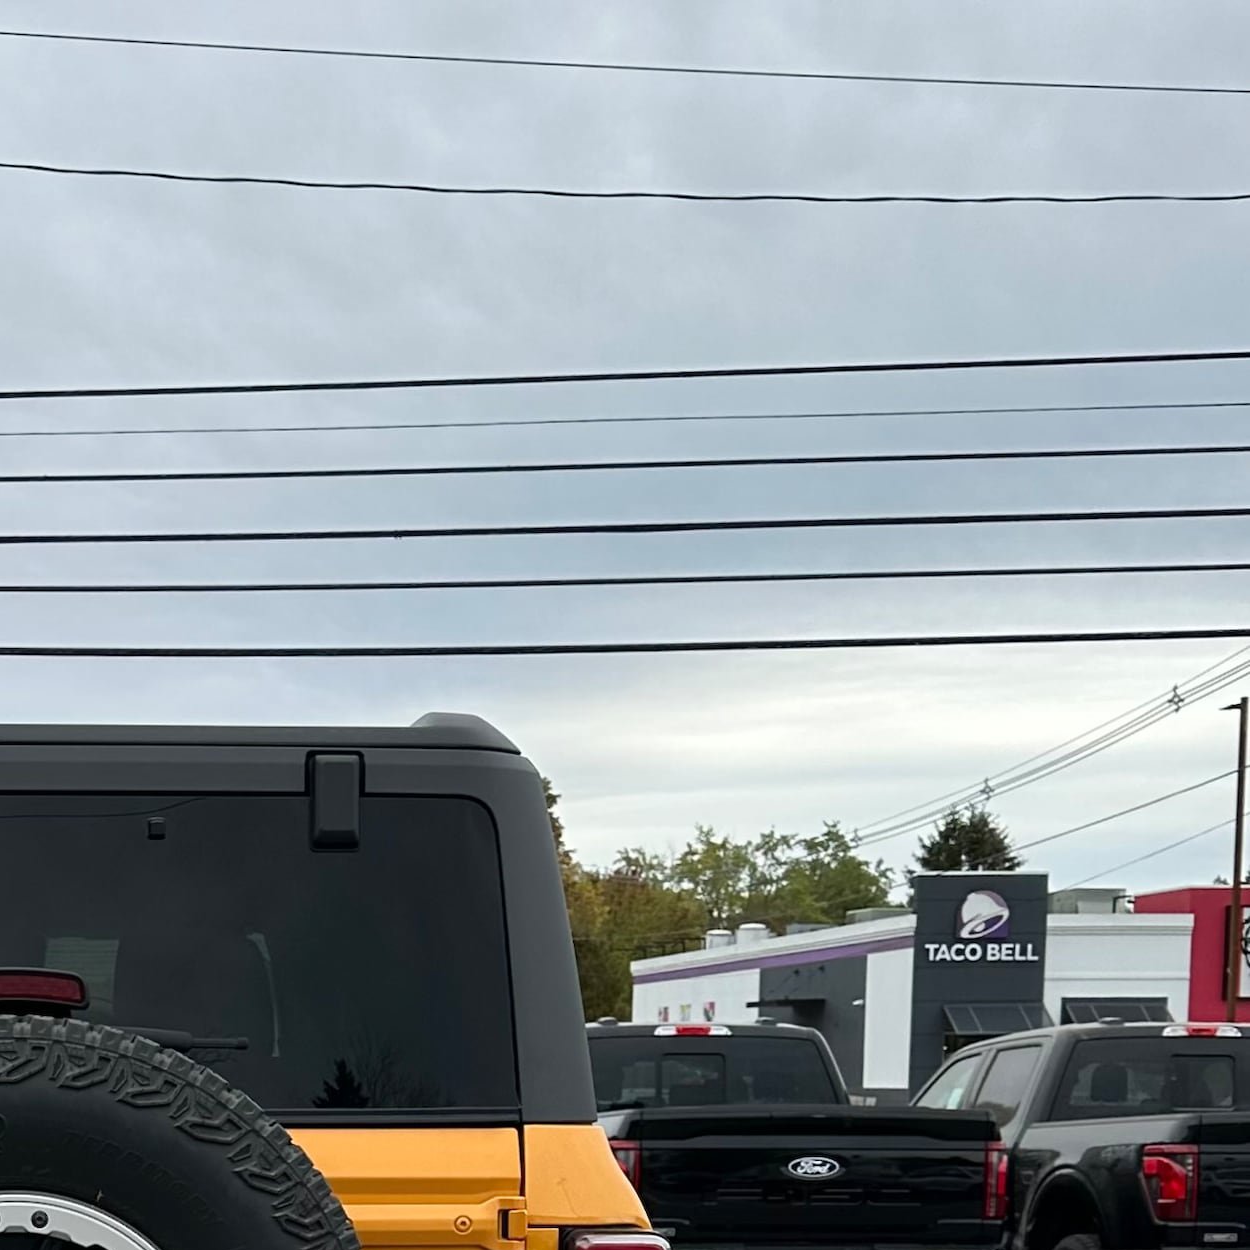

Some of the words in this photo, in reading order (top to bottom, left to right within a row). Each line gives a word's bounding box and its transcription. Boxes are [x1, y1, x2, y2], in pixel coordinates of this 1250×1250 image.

[924, 942, 982, 961] TACO
[986, 943, 1039, 961] BELL
[796, 1160, 831, 1174] Ford
